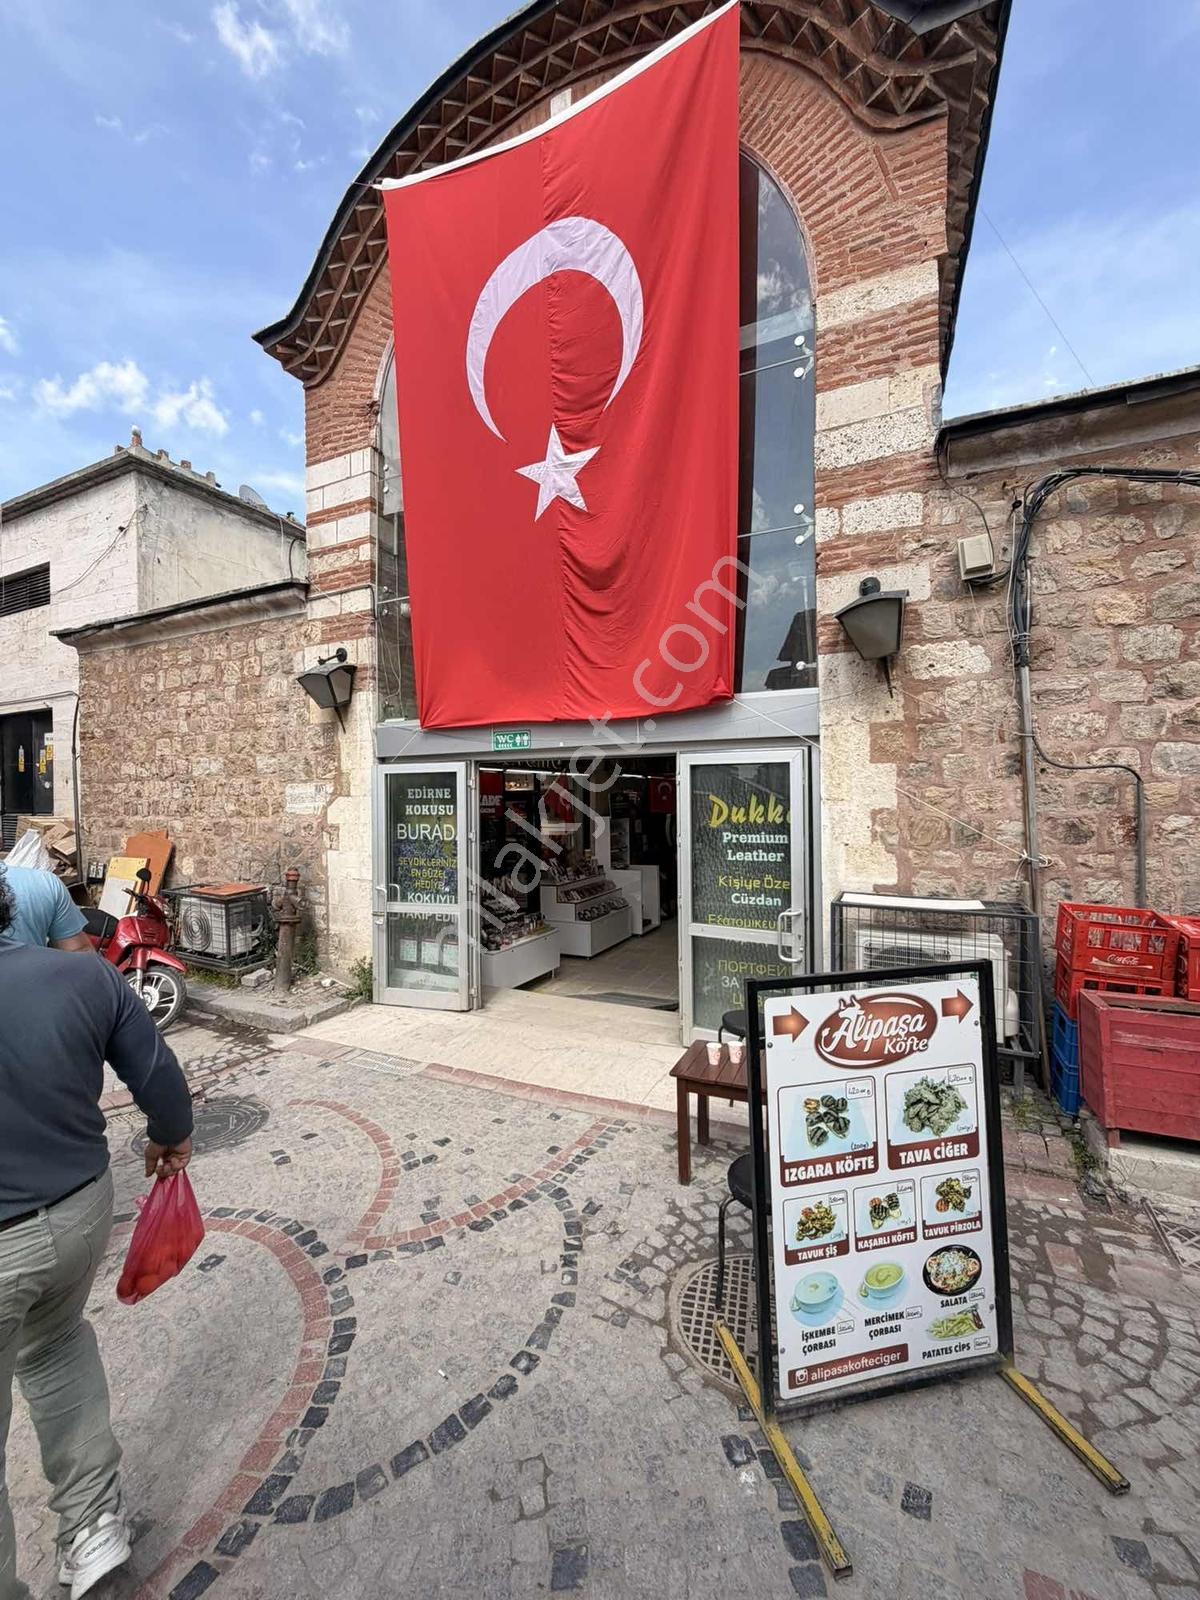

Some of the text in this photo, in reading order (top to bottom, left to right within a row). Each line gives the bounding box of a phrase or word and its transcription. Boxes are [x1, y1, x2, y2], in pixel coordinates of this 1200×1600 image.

[496, 735, 514, 743] WC
[407, 786, 451, 799] EDİRNE
[405, 805, 454, 816] KOKUSU
[708, 793, 791, 828] Dukk
[722, 832, 788, 844] Premium
[727, 849, 784, 861] Leather
[718, 875, 760, 890] Kişiye
[731, 893, 782, 906] Cüzdan
[822, 1004, 928, 1053] Alipaşa
[884, 1035, 928, 1054] Köfte
[899, 1141, 969, 1165] TAVA CİĞER
[784, 1155, 875, 1182] IZGARA KÖFTE
[924, 1220, 982, 1238] TAVUK PİRZOLA
[857, 1230, 916, 1250] KAŞARLI KÖFTE
[797, 1243, 838, 1261] TAVUK ŞİŞ
[940, 1296, 968, 1308] SALATA
[864, 1310, 905, 1327] MERCİMEK
[801, 1326, 836, 1343] İŞKEMBE
[868, 1324, 902, 1340] ÇORBASI
[802, 1339, 836, 1356] ÇORBASI
[922, 1345, 953, 1359] PATATES
[953, 1341, 971, 1353] CİPS
[811, 1351, 902, 1381] alipasakofteciger
